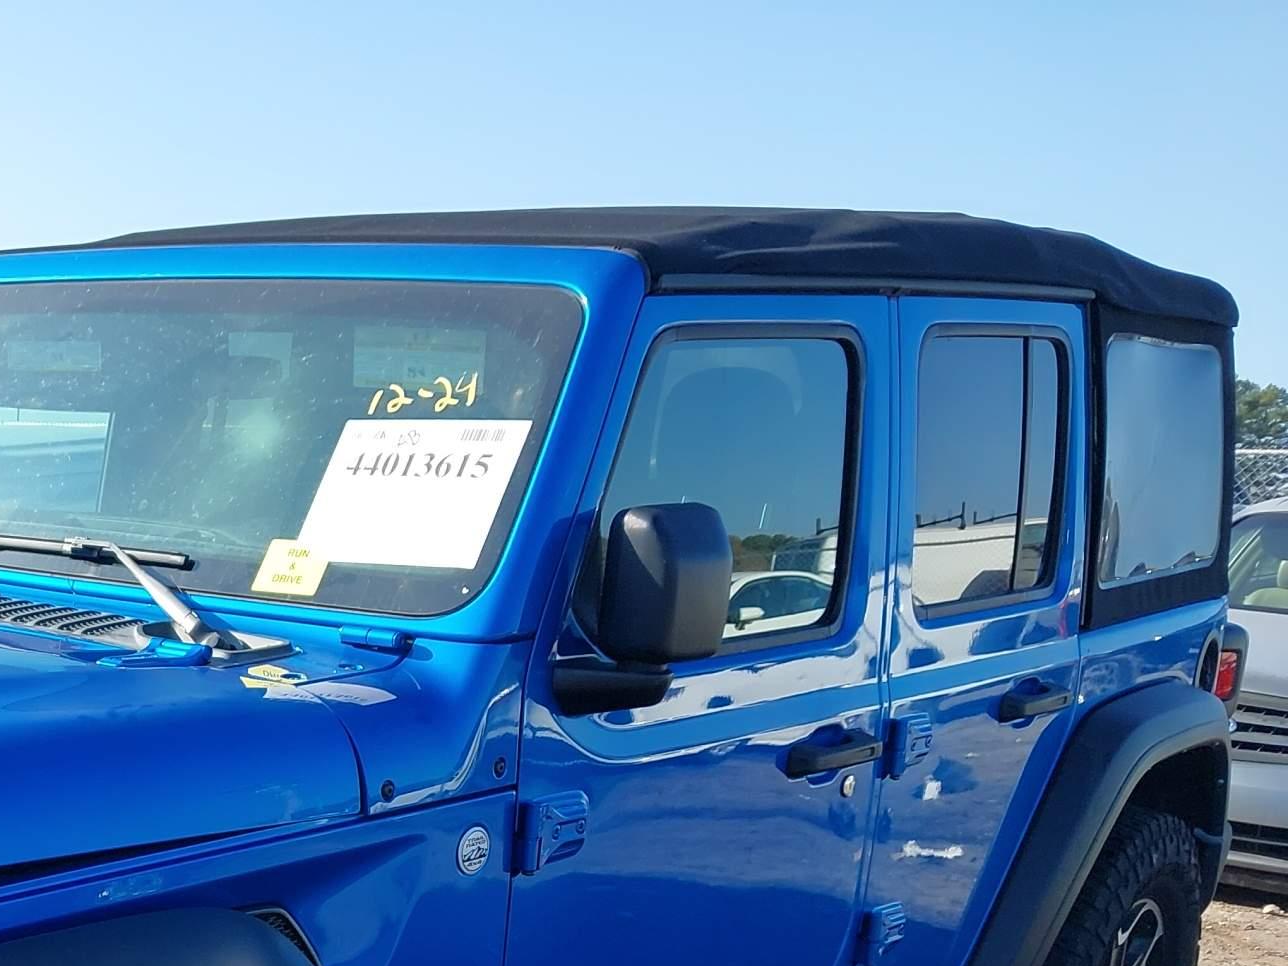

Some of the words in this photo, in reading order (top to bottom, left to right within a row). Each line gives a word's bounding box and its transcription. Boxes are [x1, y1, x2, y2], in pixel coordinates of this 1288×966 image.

[367, 371, 479, 416] 12-24
[345, 452, 494, 479] 44013615
[287, 547, 311, 558] RUN
[271, 573, 303, 585] DRIVE
